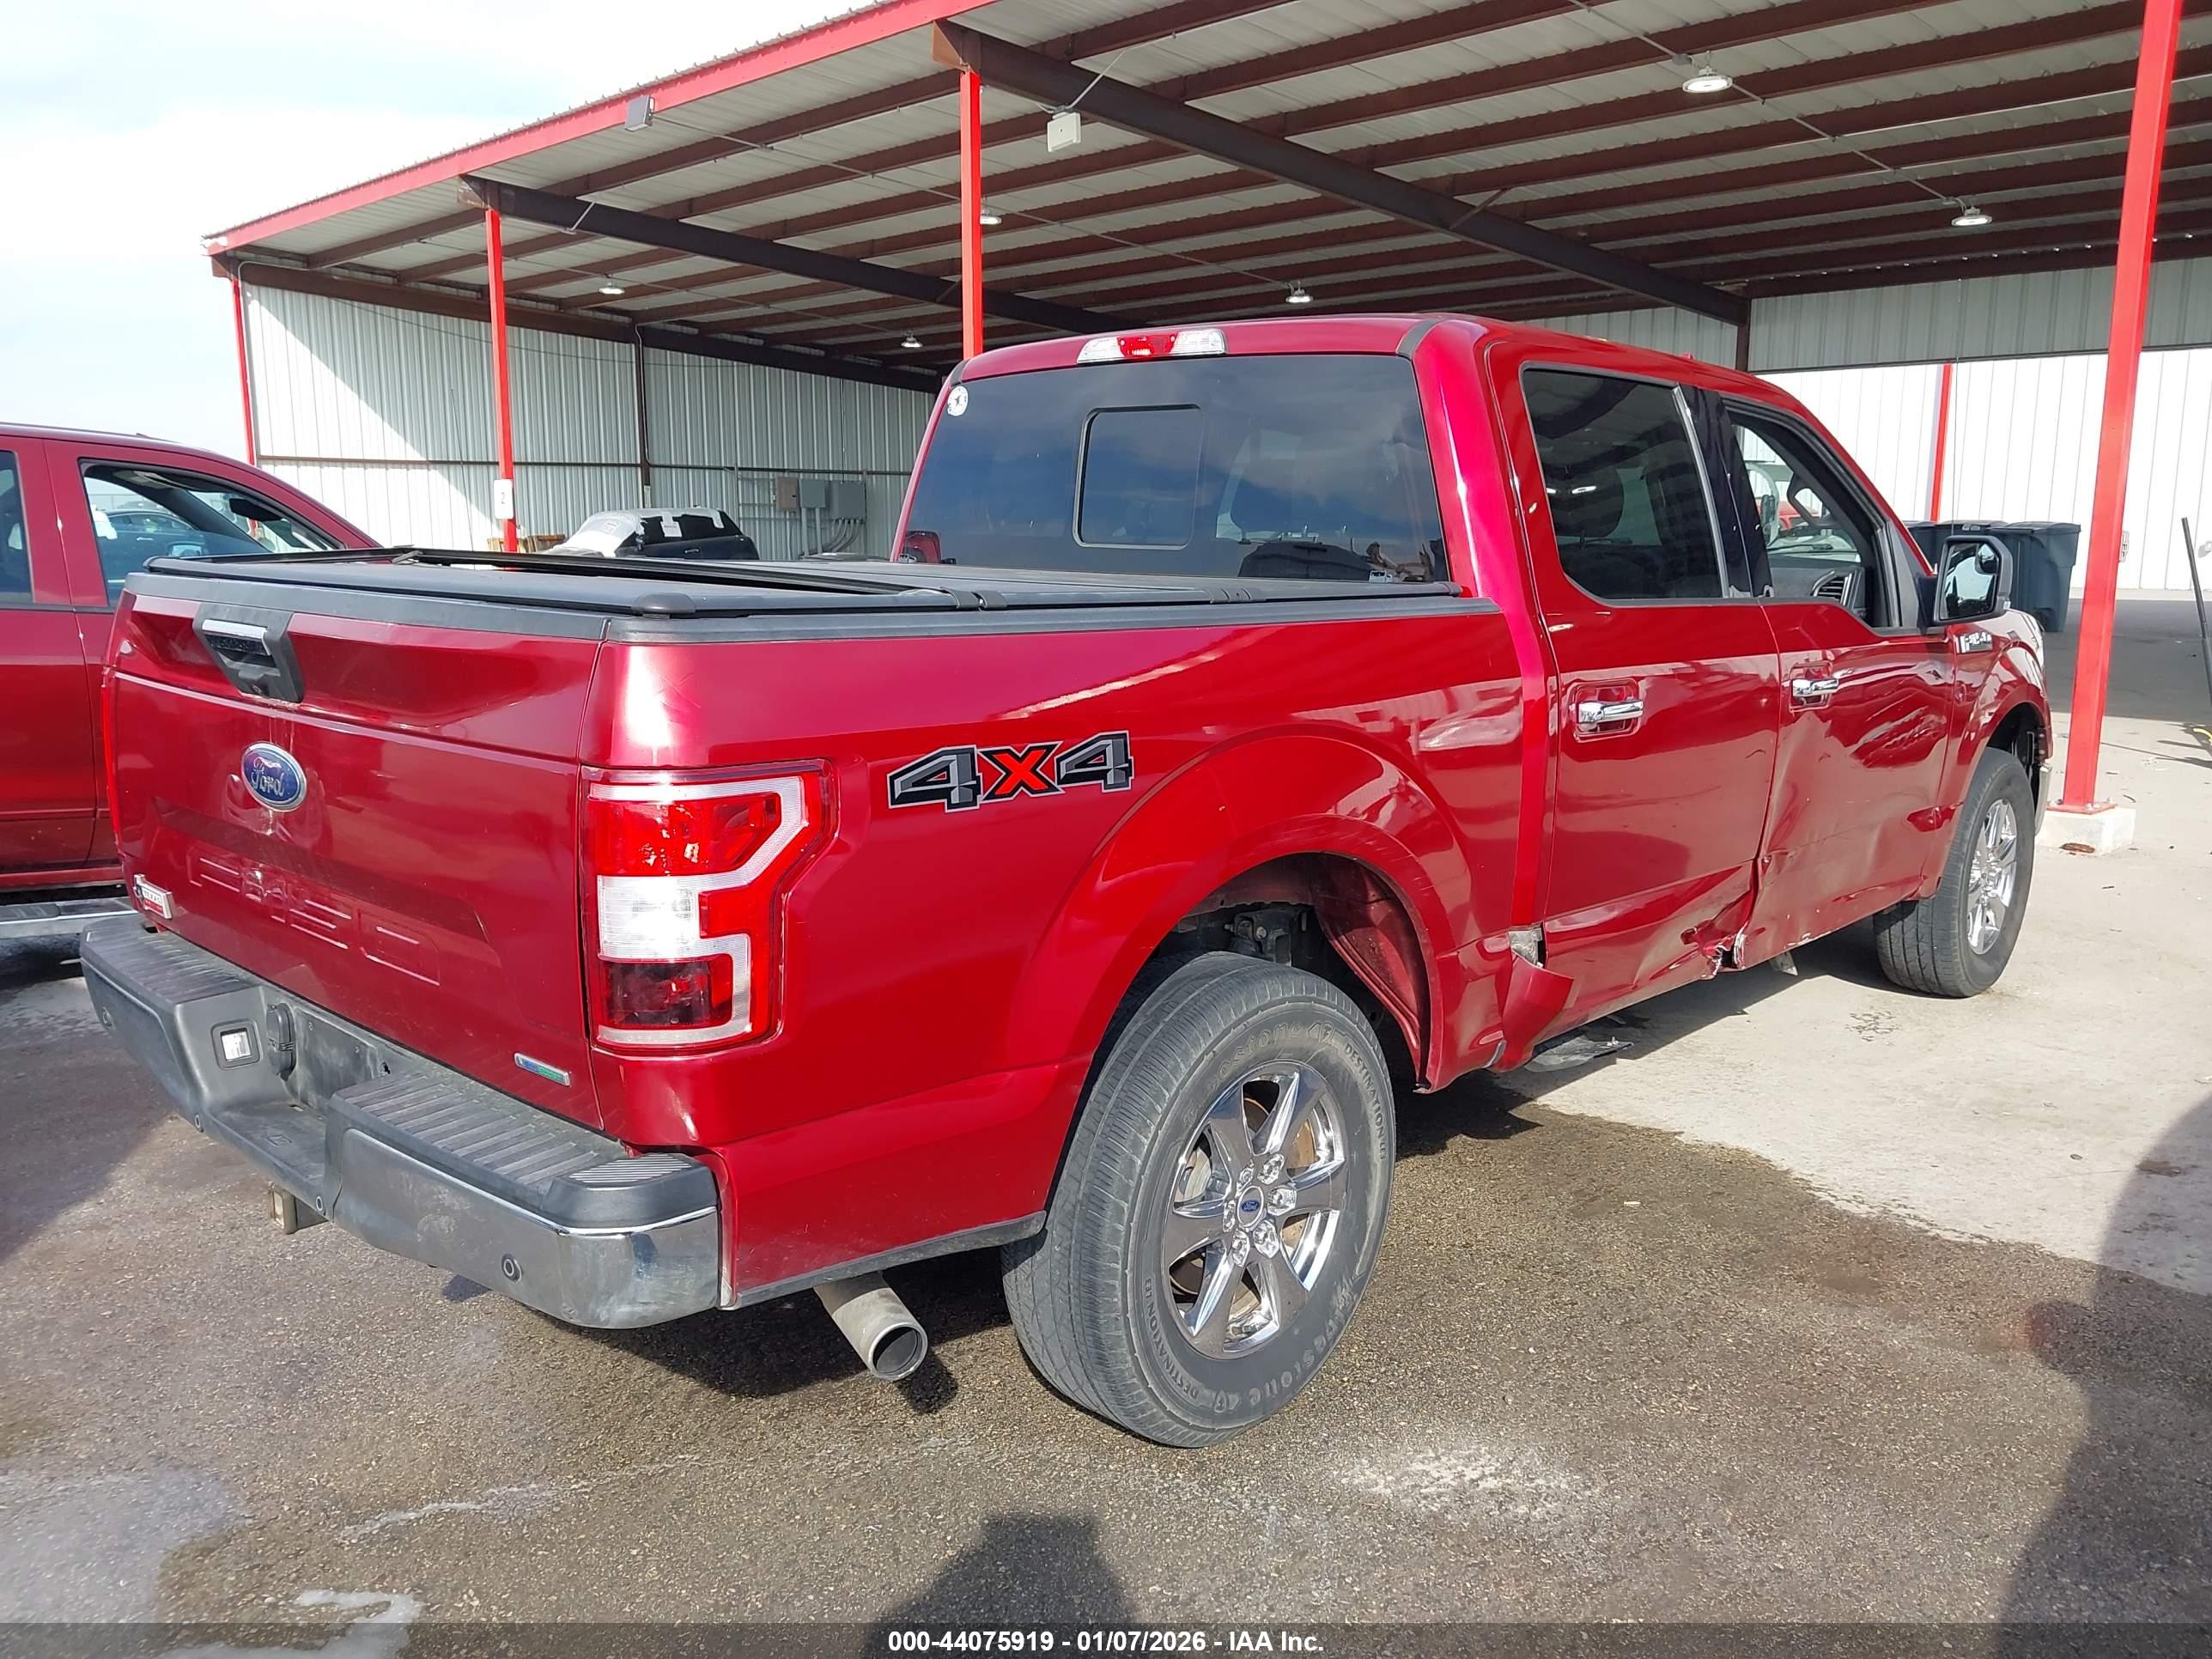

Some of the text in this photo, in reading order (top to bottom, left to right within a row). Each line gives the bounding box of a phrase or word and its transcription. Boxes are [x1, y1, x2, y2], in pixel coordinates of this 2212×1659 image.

[250, 756, 285, 797] Ford
[1344, 1042, 1384, 1139] DESTINATION
[1146, 1304, 1200, 1400] DESTINATION
